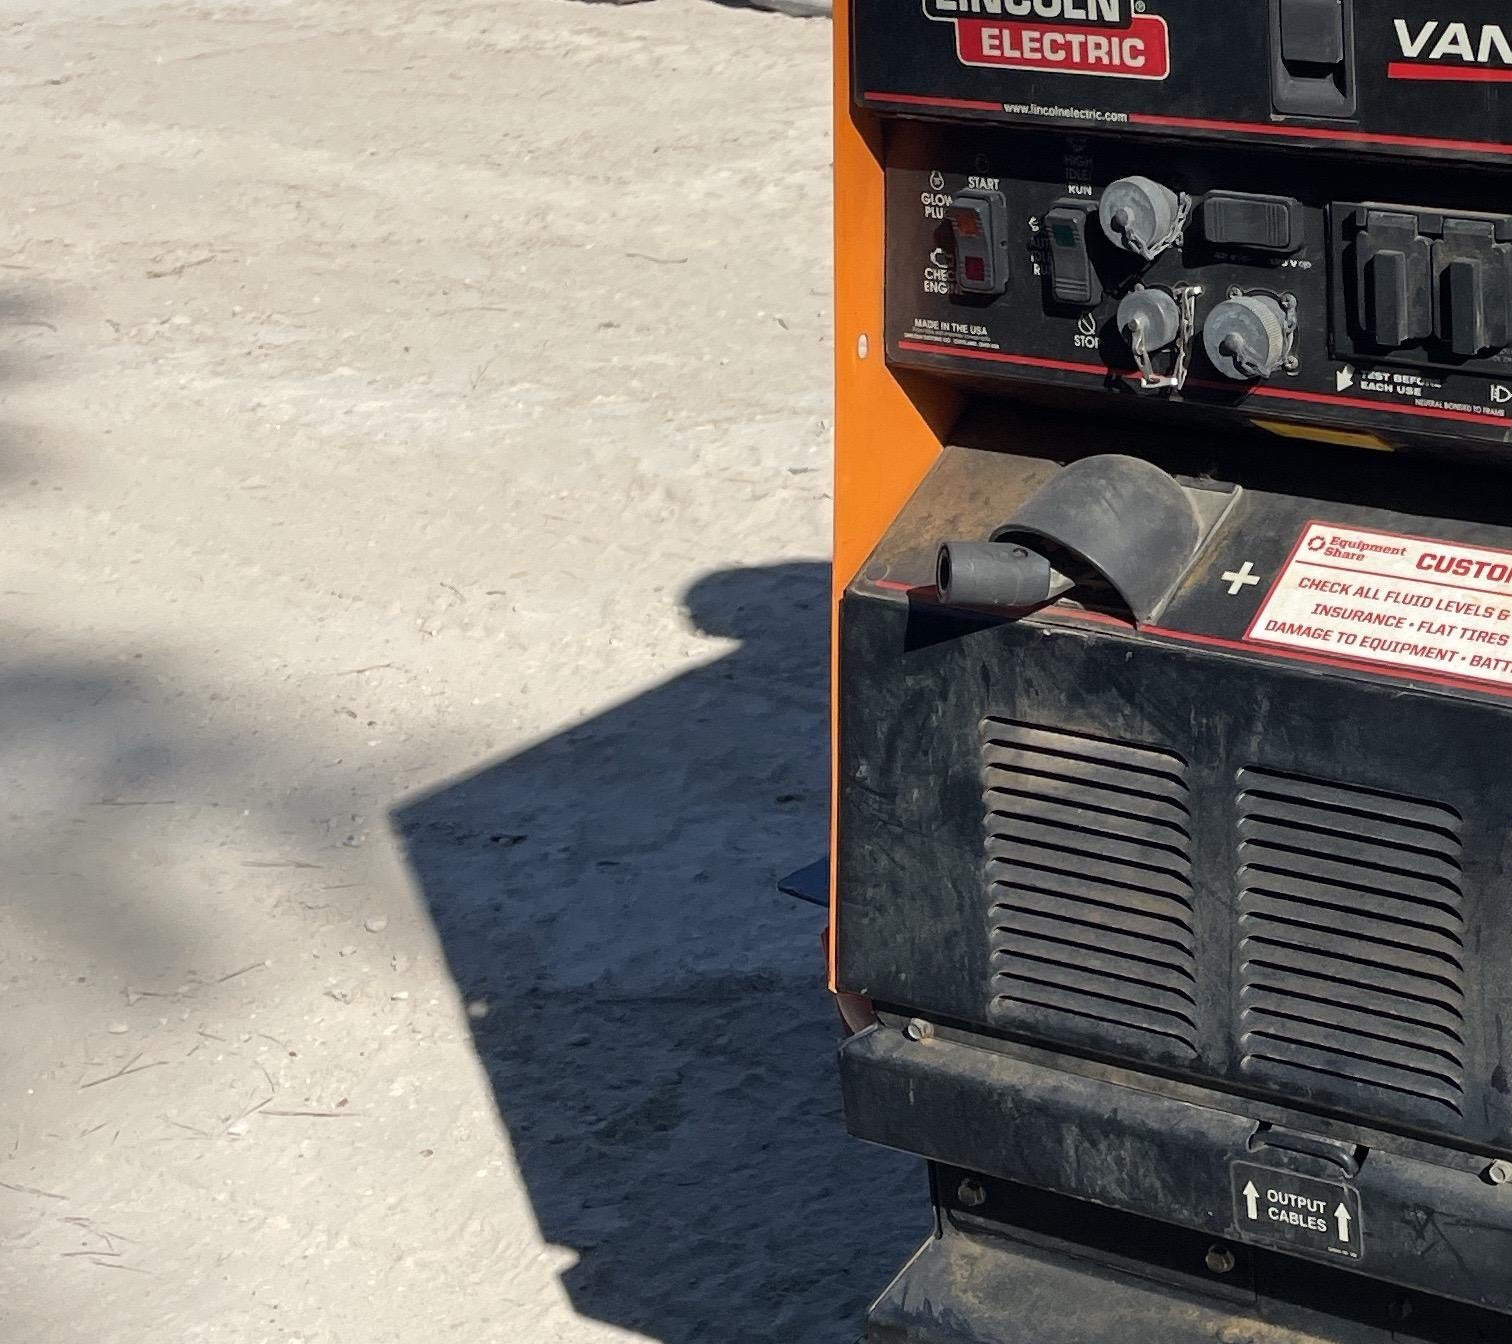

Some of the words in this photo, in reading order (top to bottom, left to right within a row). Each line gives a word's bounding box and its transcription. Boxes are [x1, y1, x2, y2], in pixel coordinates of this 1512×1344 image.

[981, 26, 1146, 68] ELECTRIC
[1004, 102, 1128, 123] www.lincolnelectric.com
[968, 175, 1000, 191] START
[924, 206, 944, 220] PLU
[923, 281, 948, 295] ENG
[915, 318, 940, 330] MADE
[940, 321, 951, 331] IN
[951, 322, 968, 333] THE
[969, 324, 988, 336] USA
[1360, 381, 1393, 395] EACH
[1395, 386, 1422, 399] USE
[1324, 545, 1365, 562] Share
[1330, 534, 1407, 560] Equipment
[1298, 576, 1352, 598] CHECK
[1353, 584, 1382, 601] ALL
[1384, 587, 1432, 609] FLUID
[1435, 596, 1496, 619] LEVELS
[1498, 607, 1511, 621] &
[1310, 602, 1407, 630] INSURANCE
[1417, 620, 1460, 639] FLAT
[1460, 628, 1509, 648] TIRES
[1264, 619, 1335, 645] DAMAGE
[1336, 631, 1357, 648] TO
[1358, 634, 1457, 664] EQUIPMENT
[1266, 1189, 1328, 1215] OUTPUT
[1267, 1206, 1328, 1233] CABLES
